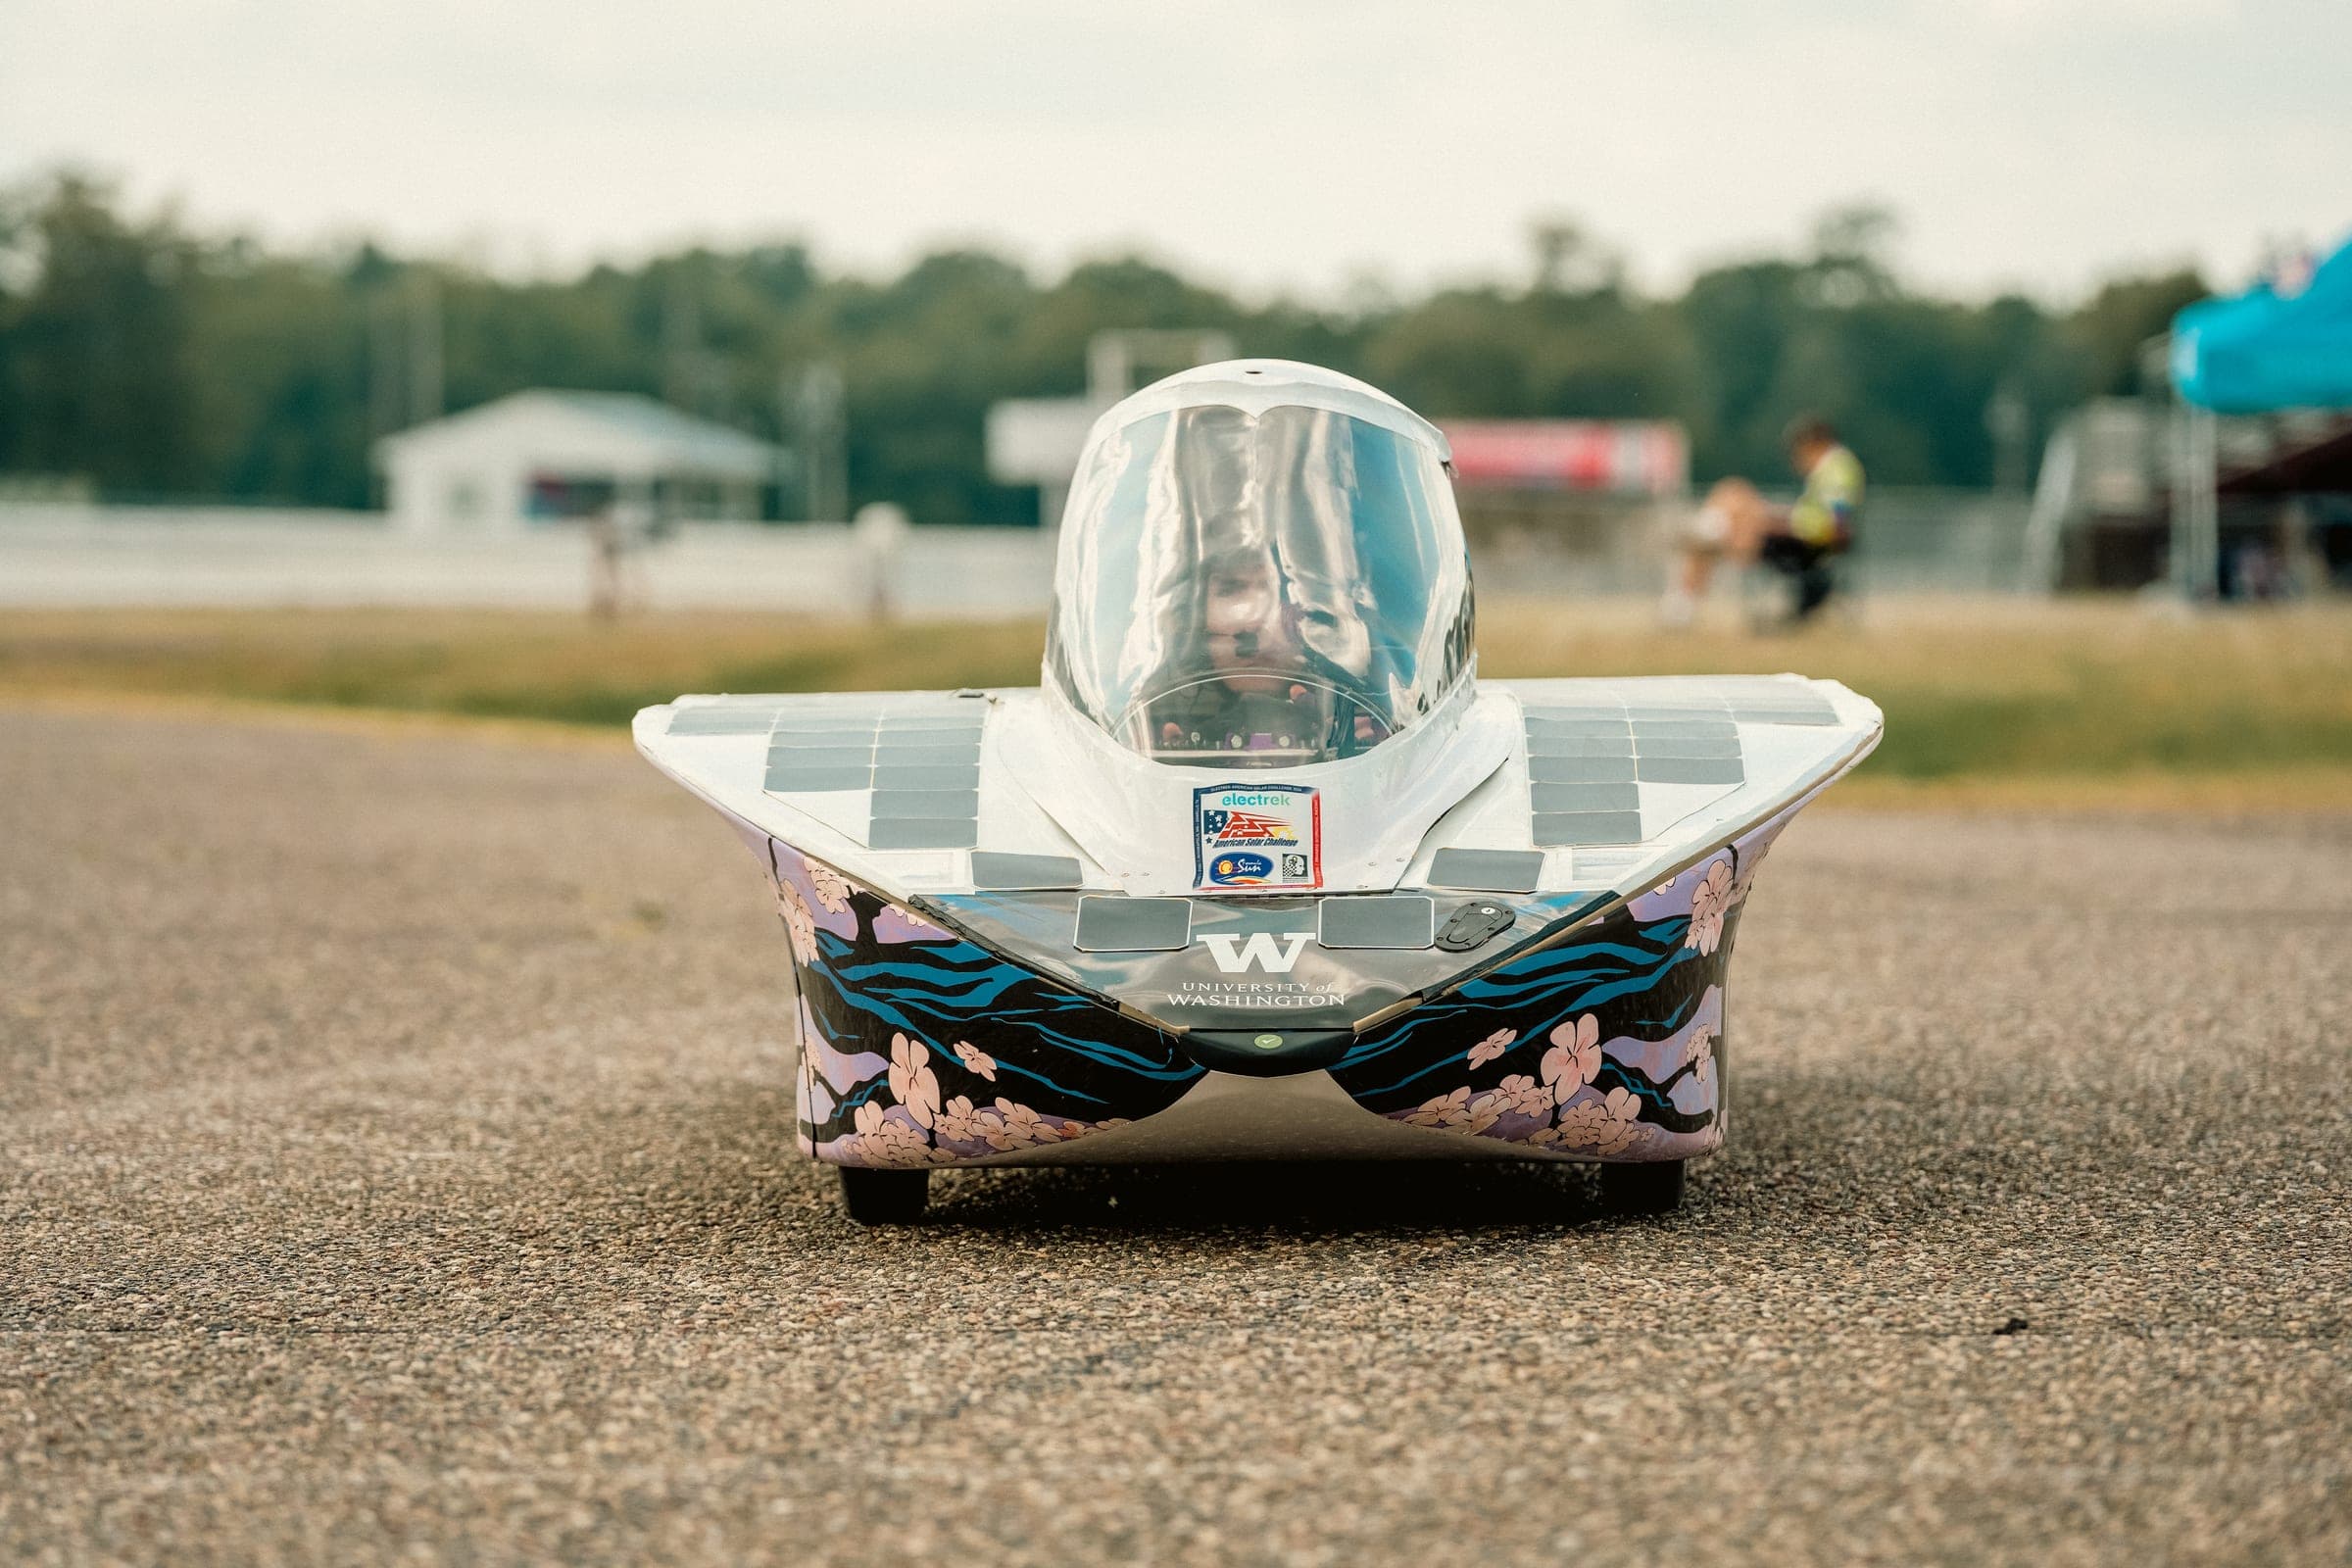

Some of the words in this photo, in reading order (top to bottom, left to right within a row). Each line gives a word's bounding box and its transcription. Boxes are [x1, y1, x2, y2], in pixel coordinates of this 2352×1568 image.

[1222, 793, 1291, 806] electrek
[1212, 838, 1244, 848] American
[1264, 838, 1298, 847] Challenge
[1237, 858, 1261, 872] Sun
[1196, 932, 1317, 973] W
[1182, 982, 1310, 993] UNIVERSITY
[1315, 981, 1334, 994] of
[1166, 994, 1346, 1006] WASHINGTON
